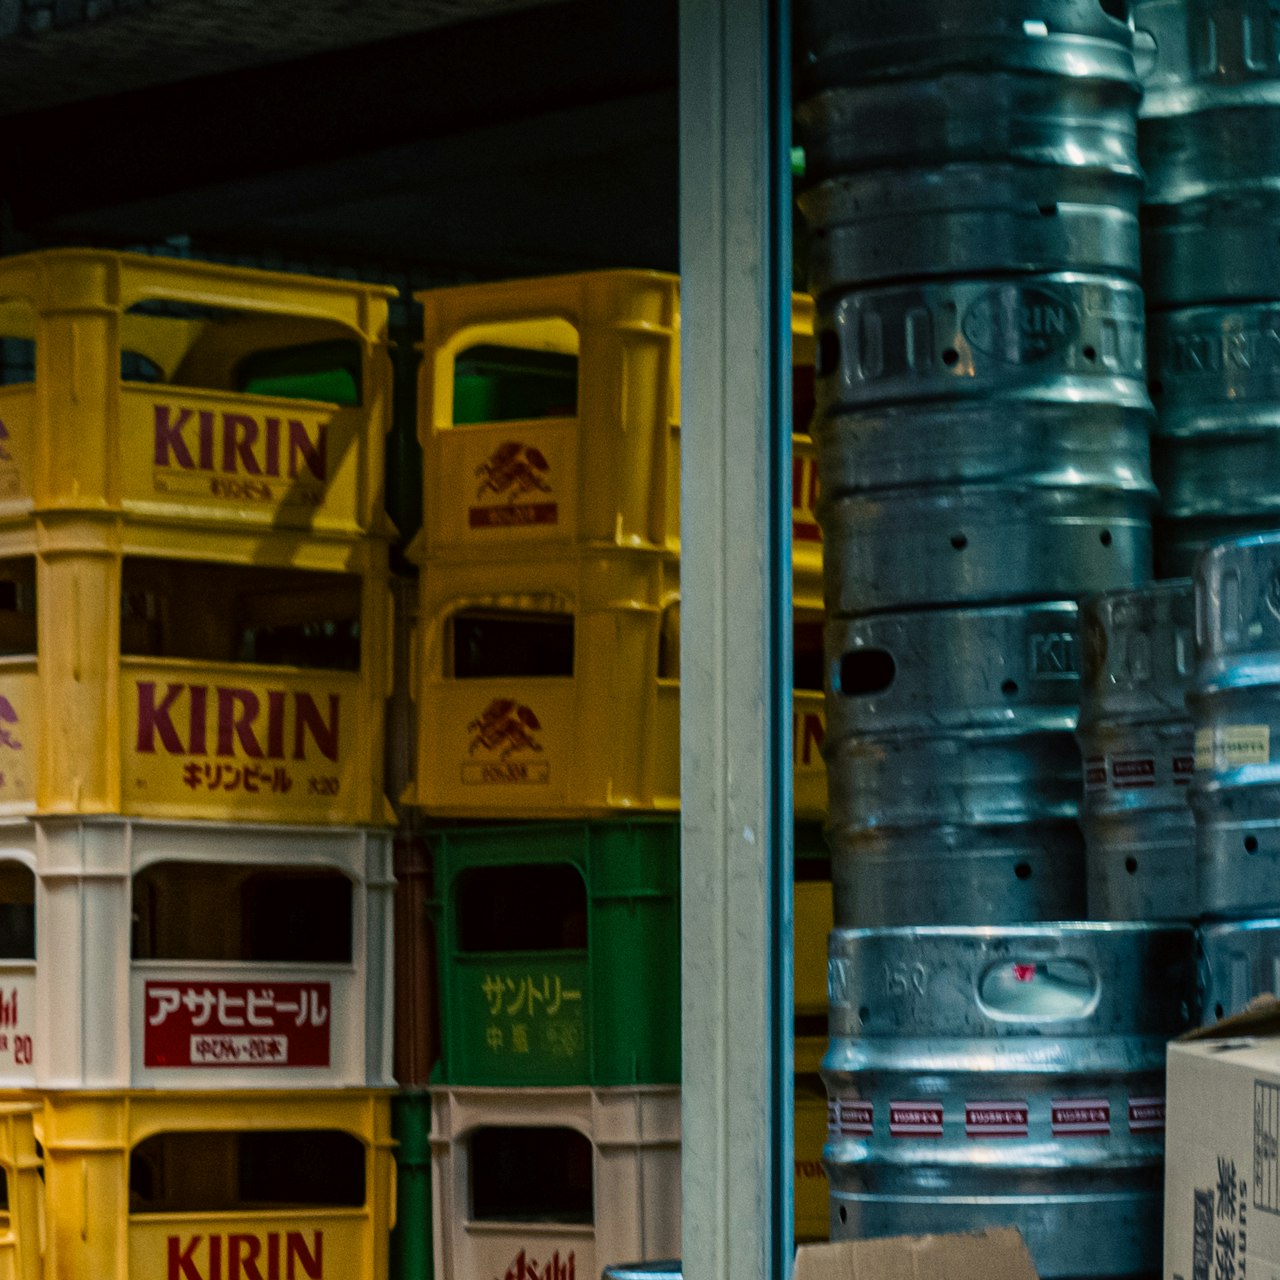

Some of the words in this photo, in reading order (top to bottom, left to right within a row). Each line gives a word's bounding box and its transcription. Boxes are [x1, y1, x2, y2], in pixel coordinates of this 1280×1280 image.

[153, 404, 327, 482] KIRIN
[135, 680, 340, 762] KIRIN
[148, 986, 328, 1028] アサヒビール
[482, 974, 581, 1016] サントリー
[14, 1034, 34, 1065] 20
